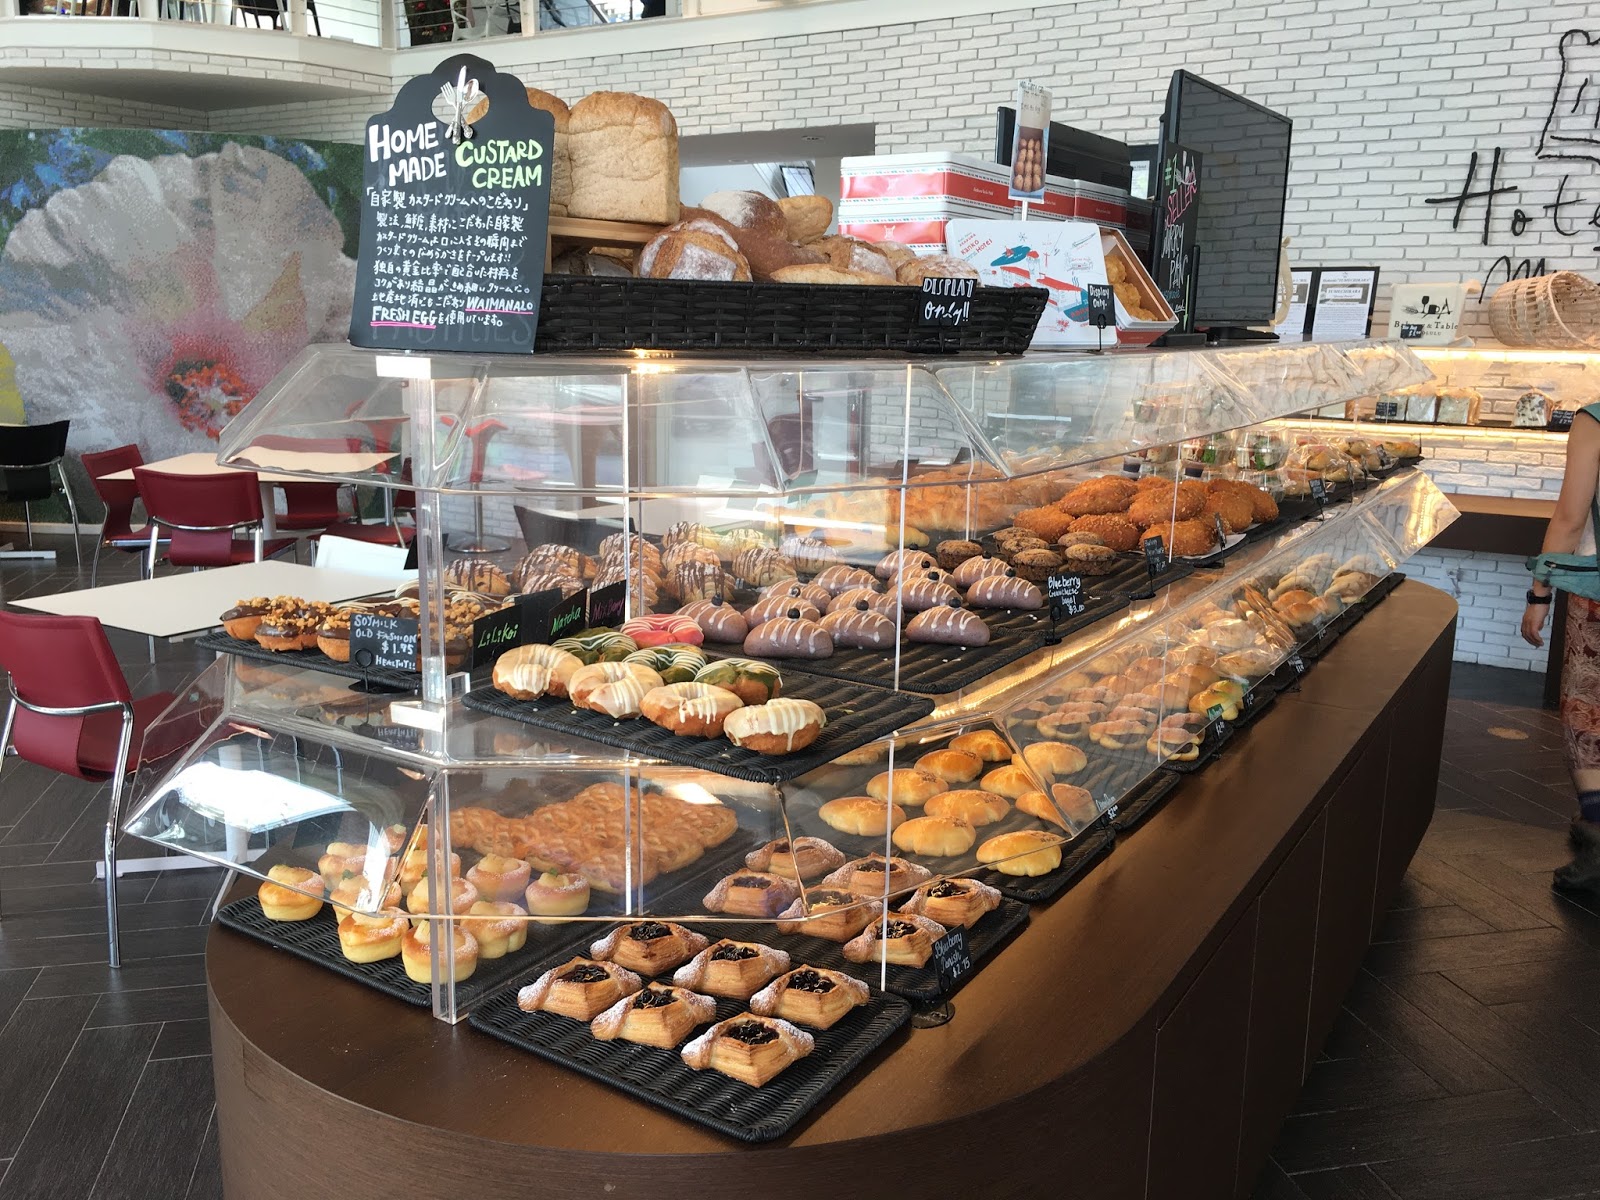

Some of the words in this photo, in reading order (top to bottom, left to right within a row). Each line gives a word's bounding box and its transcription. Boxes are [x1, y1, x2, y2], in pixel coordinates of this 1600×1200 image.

[368, 121, 439, 163] HOME
[455, 138, 544, 168] CUSTARD
[388, 152, 447, 187] MADE
[471, 164, 543, 190] CREAM
[922, 277, 974, 298] DISPLAY
[1089, 284, 1110, 299] Display
[466, 295, 533, 312] WAIMANALO
[371, 305, 410, 322] FRESH
[411, 309, 438, 326] EGG
[1434, 321, 1459, 330] Table
[354, 614, 398, 630] SOYMILK
[355, 628, 374, 638] OLD
[376, 630, 417, 644] FASHION
